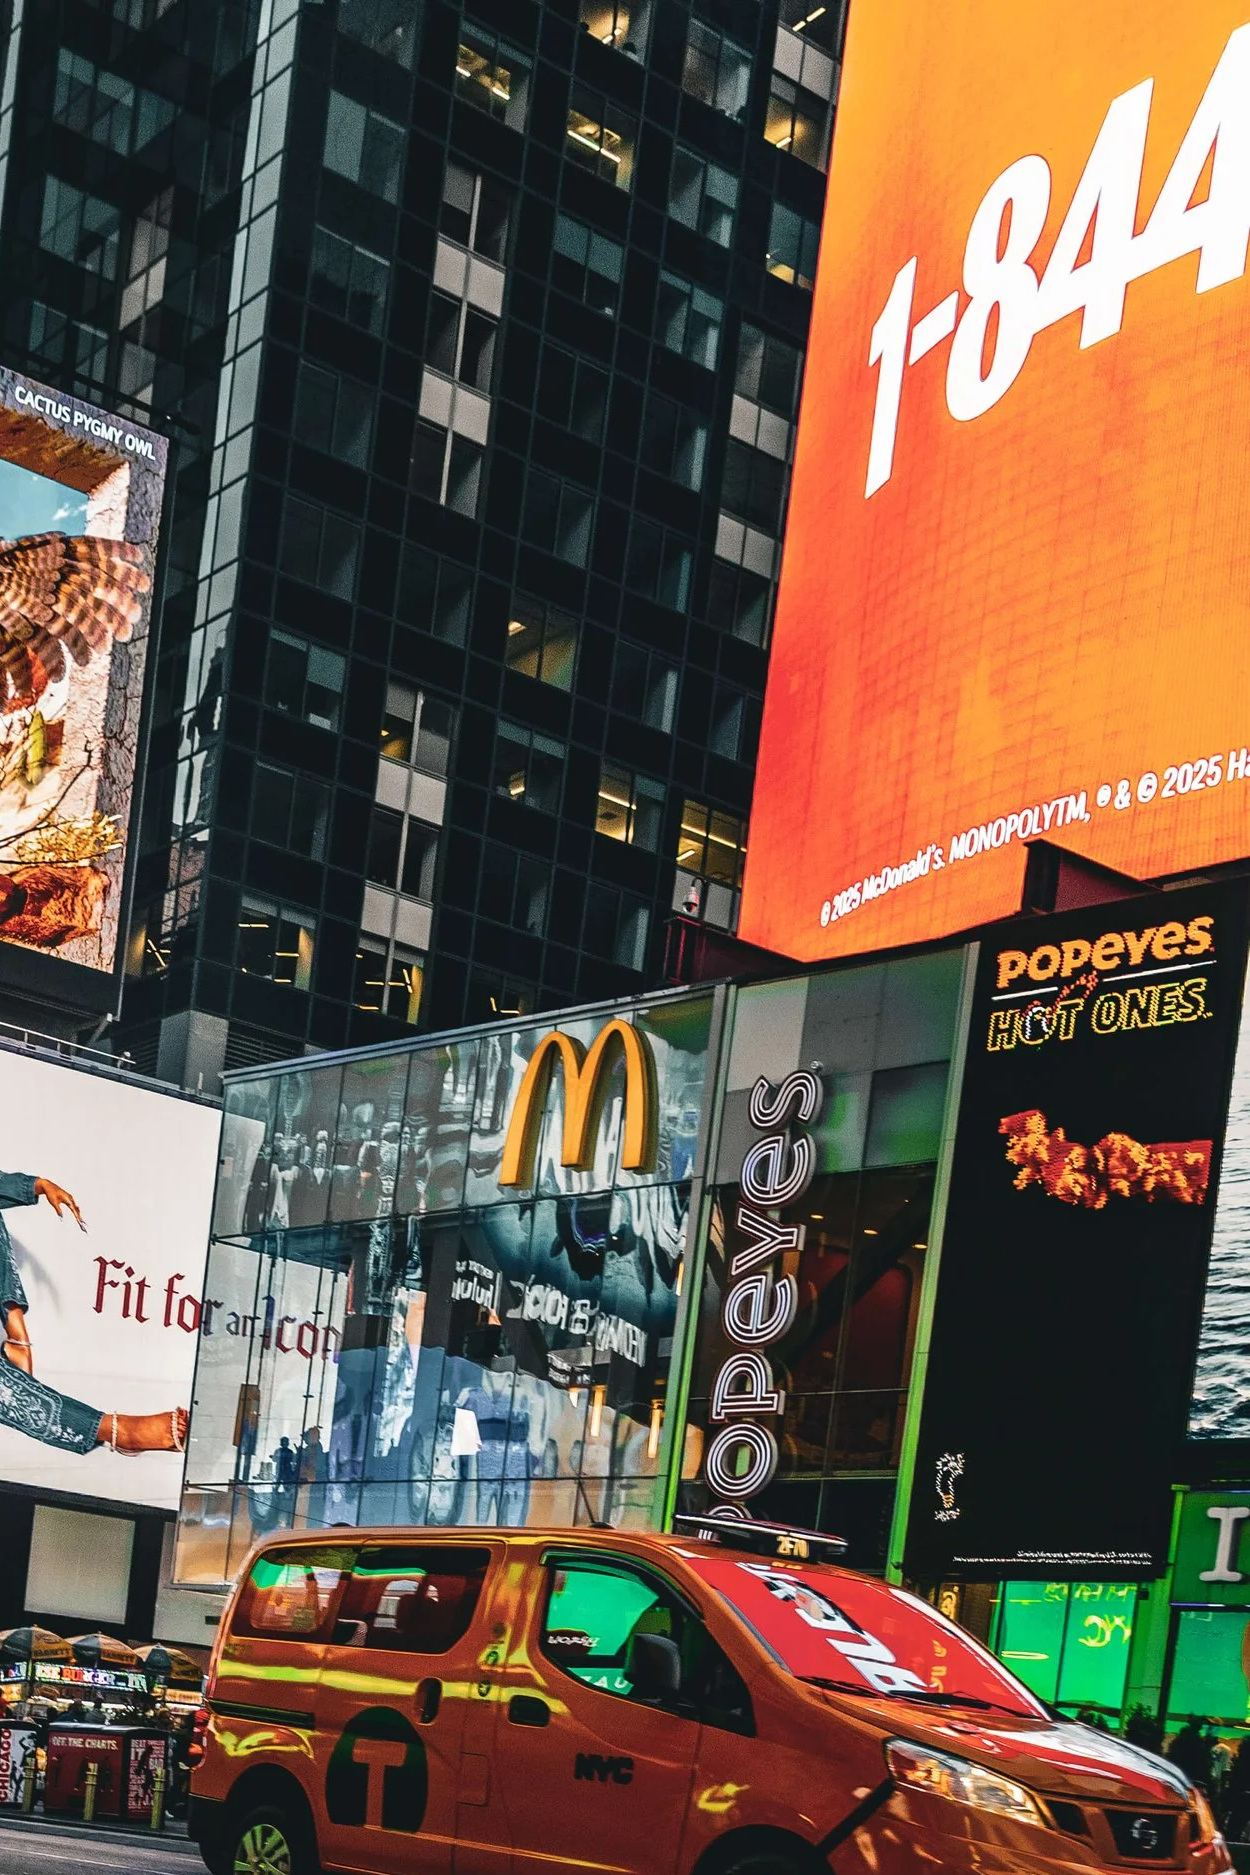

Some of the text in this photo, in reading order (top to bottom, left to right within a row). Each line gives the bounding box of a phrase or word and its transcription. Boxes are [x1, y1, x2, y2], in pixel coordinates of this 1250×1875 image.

[14, 386, 157, 461] CACTUS PYGMY OWL
[830, 883, 862, 922] 2025
[1113, 779, 1132, 810] &
[1161, 754, 1223, 799] 2025
[987, 998, 1085, 1052] HOT
[93, 1256, 344, 1364] Fit for an Icon
[68, 1737, 84, 1749] THE
[573, 1751, 635, 1785] NYC
[352, 1738, 407, 1827] T
